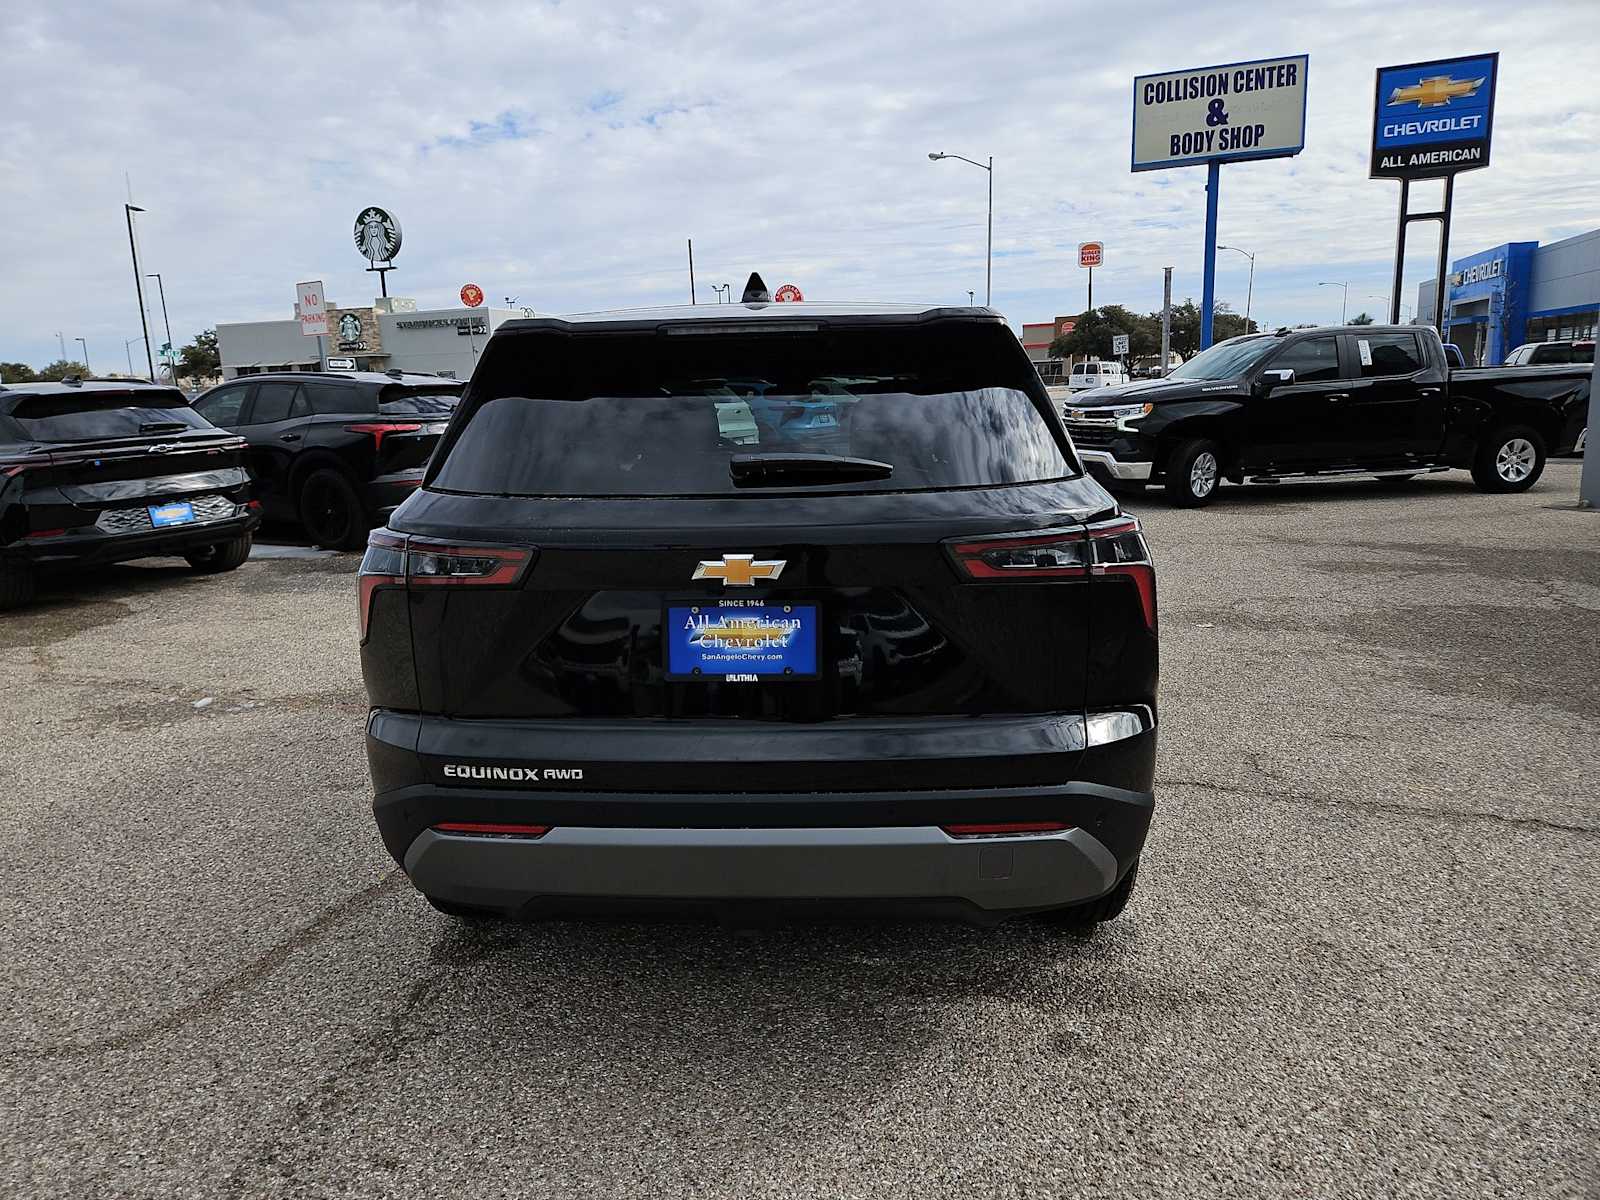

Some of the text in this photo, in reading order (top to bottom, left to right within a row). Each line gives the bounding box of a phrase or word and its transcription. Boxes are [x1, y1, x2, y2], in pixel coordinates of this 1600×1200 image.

[1144, 63, 1297, 105] COLLISION CENTER
[1206, 98, 1228, 126] &
[1384, 115, 1481, 137] CHEVROLET
[1170, 124, 1265, 156] BODY SHOP
[1380, 147, 1481, 169] ALL AMERICAN
[1081, 254, 1101, 262] KING
[1464, 260, 1502, 283] CHEVROLET
[304, 294, 318, 306] NO
[684, 615, 801, 629] All American
[700, 634, 788, 649] Chevrolet
[702, 653, 783, 661] SanAngeloChevy.com
[733, 674, 759, 682] LITHIA
[443, 764, 583, 781] EQUINOX AWD
